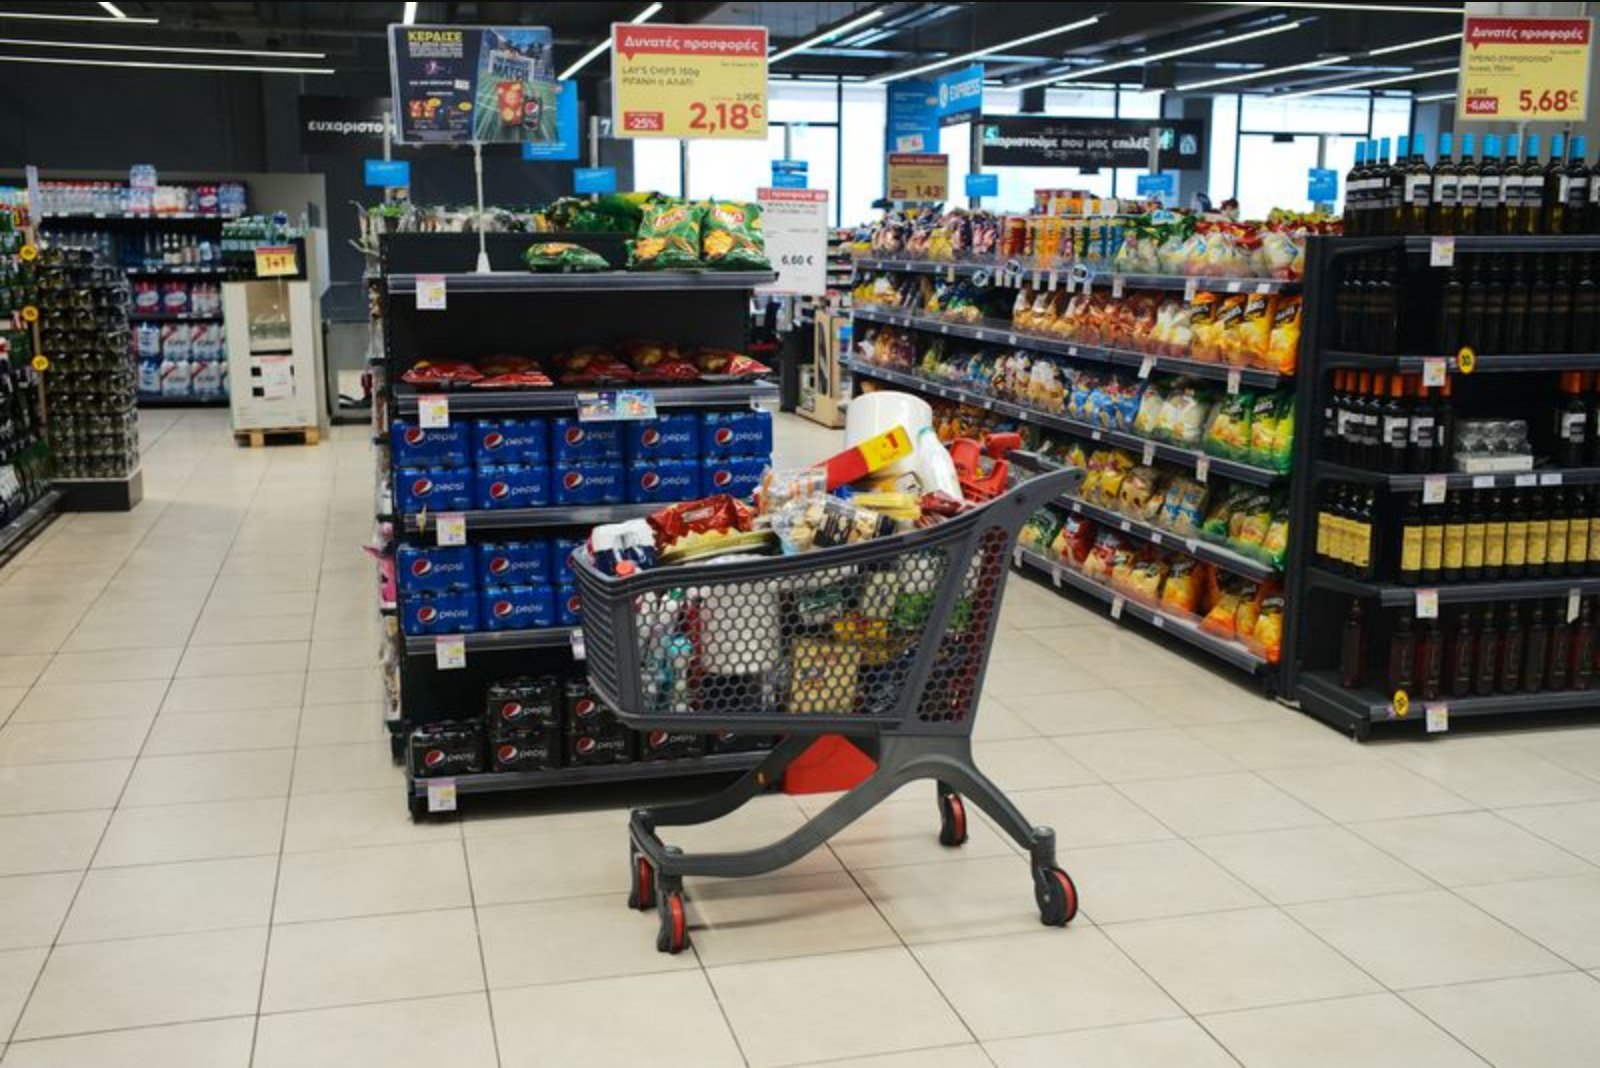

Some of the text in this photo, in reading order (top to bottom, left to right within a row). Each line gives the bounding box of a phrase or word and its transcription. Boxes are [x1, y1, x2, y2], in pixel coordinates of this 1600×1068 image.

[1471, 26, 1584, 40] Δυνατές προσφορές
[624, 35, 759, 52] Δυνατές προσφορές
[650, 66, 676, 76] CHIPS
[1519, 89, 1579, 114] 5,68€
[629, 116, 659, 129] -25%
[689, 101, 763, 134] 2,18€
[265, 256, 287, 271] 1+1
[505, 435, 534, 446] pepsi
[662, 433, 690, 443] pepsi
[734, 432, 763, 442] pepsi
[585, 475, 615, 486] pepsi
[661, 475, 690, 486] pepsi
[733, 474, 760, 484] peps
[434, 482, 465, 493] pepsi
[511, 484, 541, 496] pepsi
[433, 562, 464, 573] pepsi
[511, 560, 541, 571] pepsi
[439, 608, 469, 619] pepsi
[514, 603, 543, 615] pepsi
